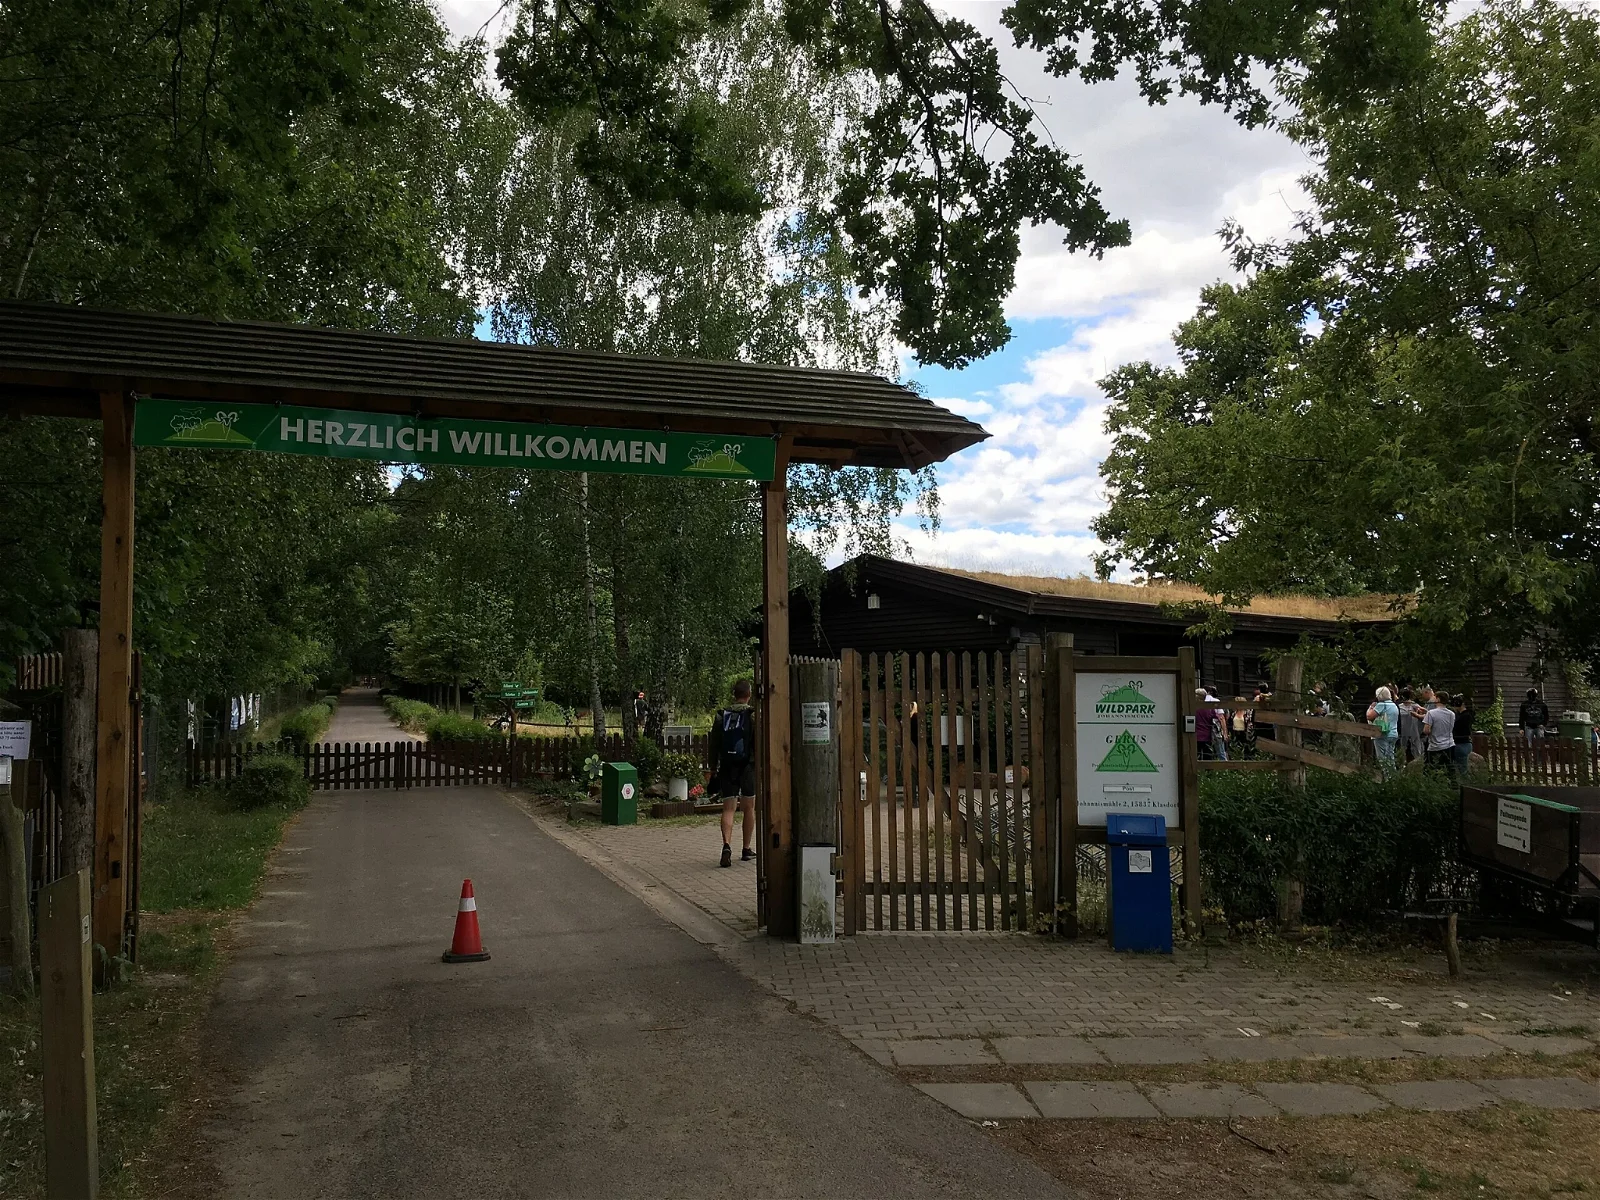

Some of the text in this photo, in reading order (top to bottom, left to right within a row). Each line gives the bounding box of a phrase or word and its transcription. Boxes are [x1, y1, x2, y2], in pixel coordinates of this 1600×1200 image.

[279, 416, 668, 465] HERZLICH WILLKOMMEN
[1096, 704, 1156, 714] WILDPARK
[1106, 735, 1147, 744] GERUS
